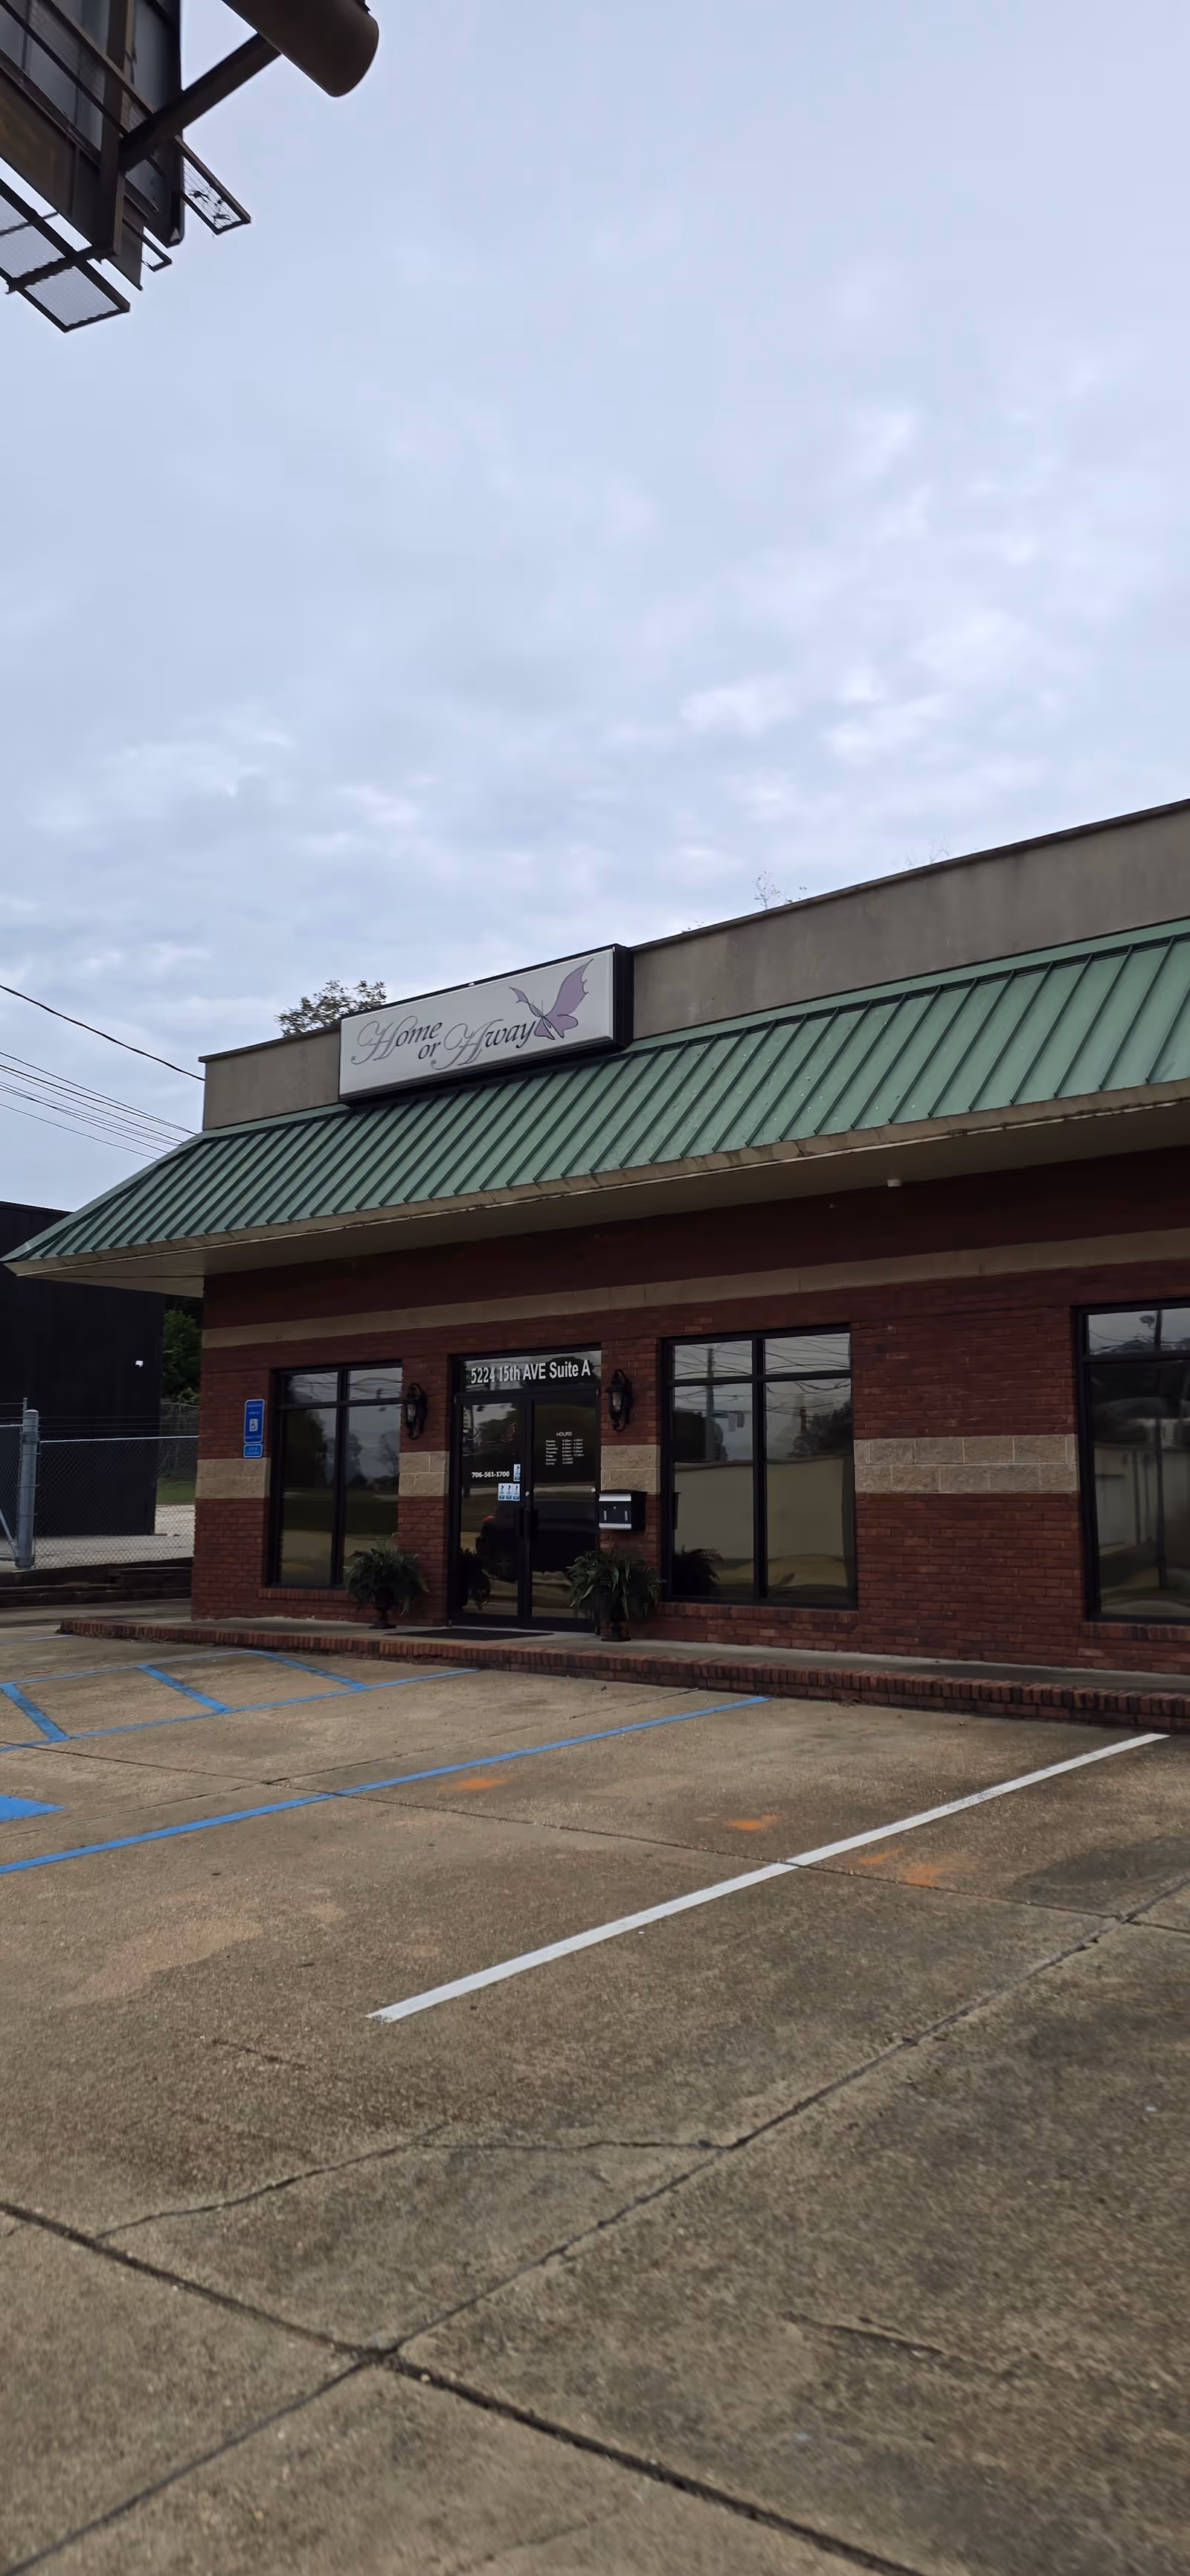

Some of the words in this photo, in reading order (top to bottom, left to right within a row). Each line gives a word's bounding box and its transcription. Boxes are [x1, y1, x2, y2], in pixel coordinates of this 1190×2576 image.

[351, 1015, 443, 1065] Home
[418, 1041, 442, 1059] or
[431, 1018, 536, 1070] Away
[471, 1366, 495, 1384] 5224
[499, 1364, 521, 1382] 15th
[523, 1363, 547, 1381] AVE
[549, 1361, 579, 1378] Suite
[581, 1359, 591, 1376] A
